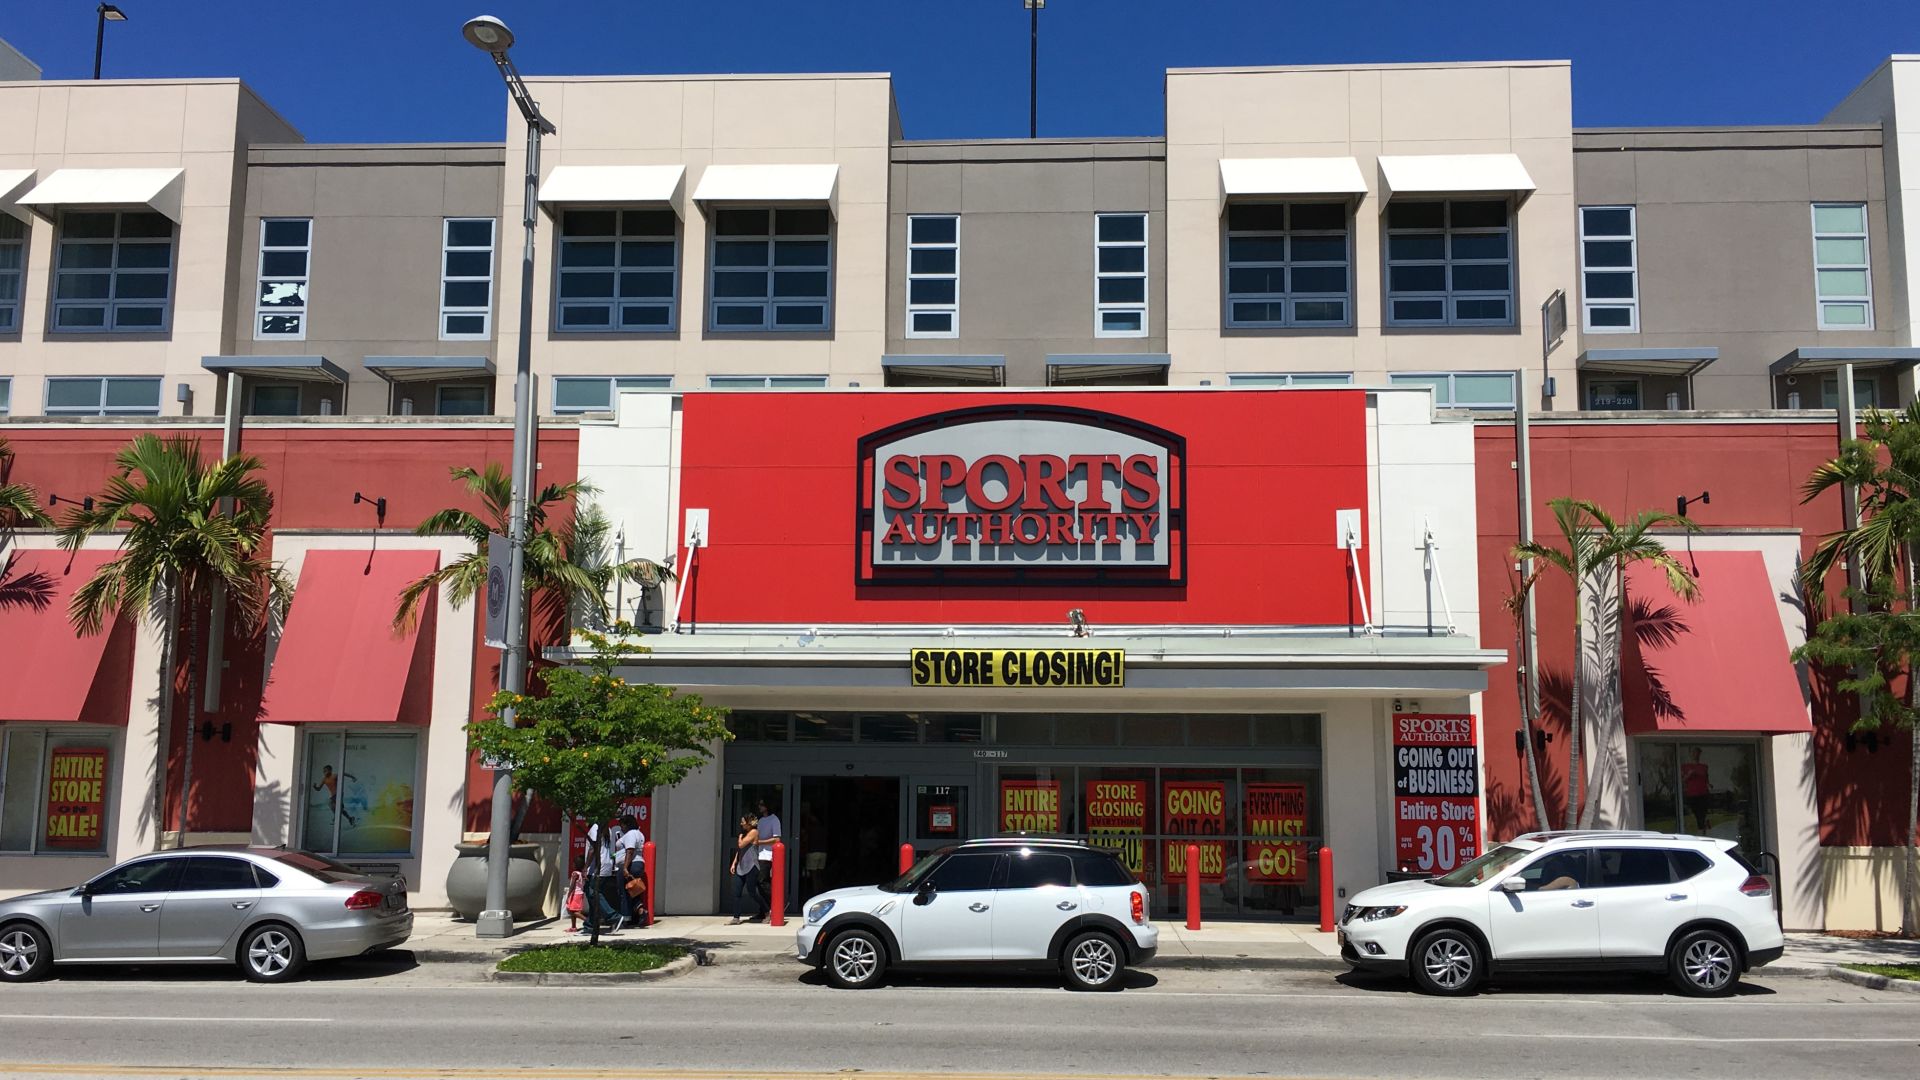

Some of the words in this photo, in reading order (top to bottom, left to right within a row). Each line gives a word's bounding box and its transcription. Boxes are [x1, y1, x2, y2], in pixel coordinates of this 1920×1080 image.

[882, 454, 1160, 510] SPORTS
[881, 512, 1160, 545] AUTHORITY
[914, 651, 994, 685] STORE
[1001, 651, 1121, 686] CLOSING!
[1399, 719, 1471, 733] SPORTS
[53, 757, 104, 779] ENTIRE
[1398, 747, 1443, 768] GOING
[1447, 747, 1474, 768] OUT
[51, 781, 102, 803] STORE
[936, 786, 950, 795] 117
[1096, 784, 1137, 800] STORE
[1397, 777, 1408, 788] of
[1408, 769, 1474, 794] BUSINESS
[1005, 789, 1057, 812] ENTIRE
[1089, 802, 1144, 817] CLOSING
[1168, 789, 1222, 815] GOING
[1249, 791, 1304, 816] EVERYTHING
[1400, 800, 1438, 821] Entire
[1441, 800, 1475, 821] Store
[48, 814, 98, 837] SALE!
[1005, 813, 1058, 833] STORE
[1091, 818, 1142, 826] EVERYTHING
[1169, 818, 1198, 842] OUT
[1202, 818, 1221, 842] OF
[1252, 819, 1304, 846] MUST
[1168, 844, 1223, 874] BUESS
[1417, 825, 1456, 870] 30
[1459, 846, 1475, 857] off
[1258, 848, 1297, 876] GO!
